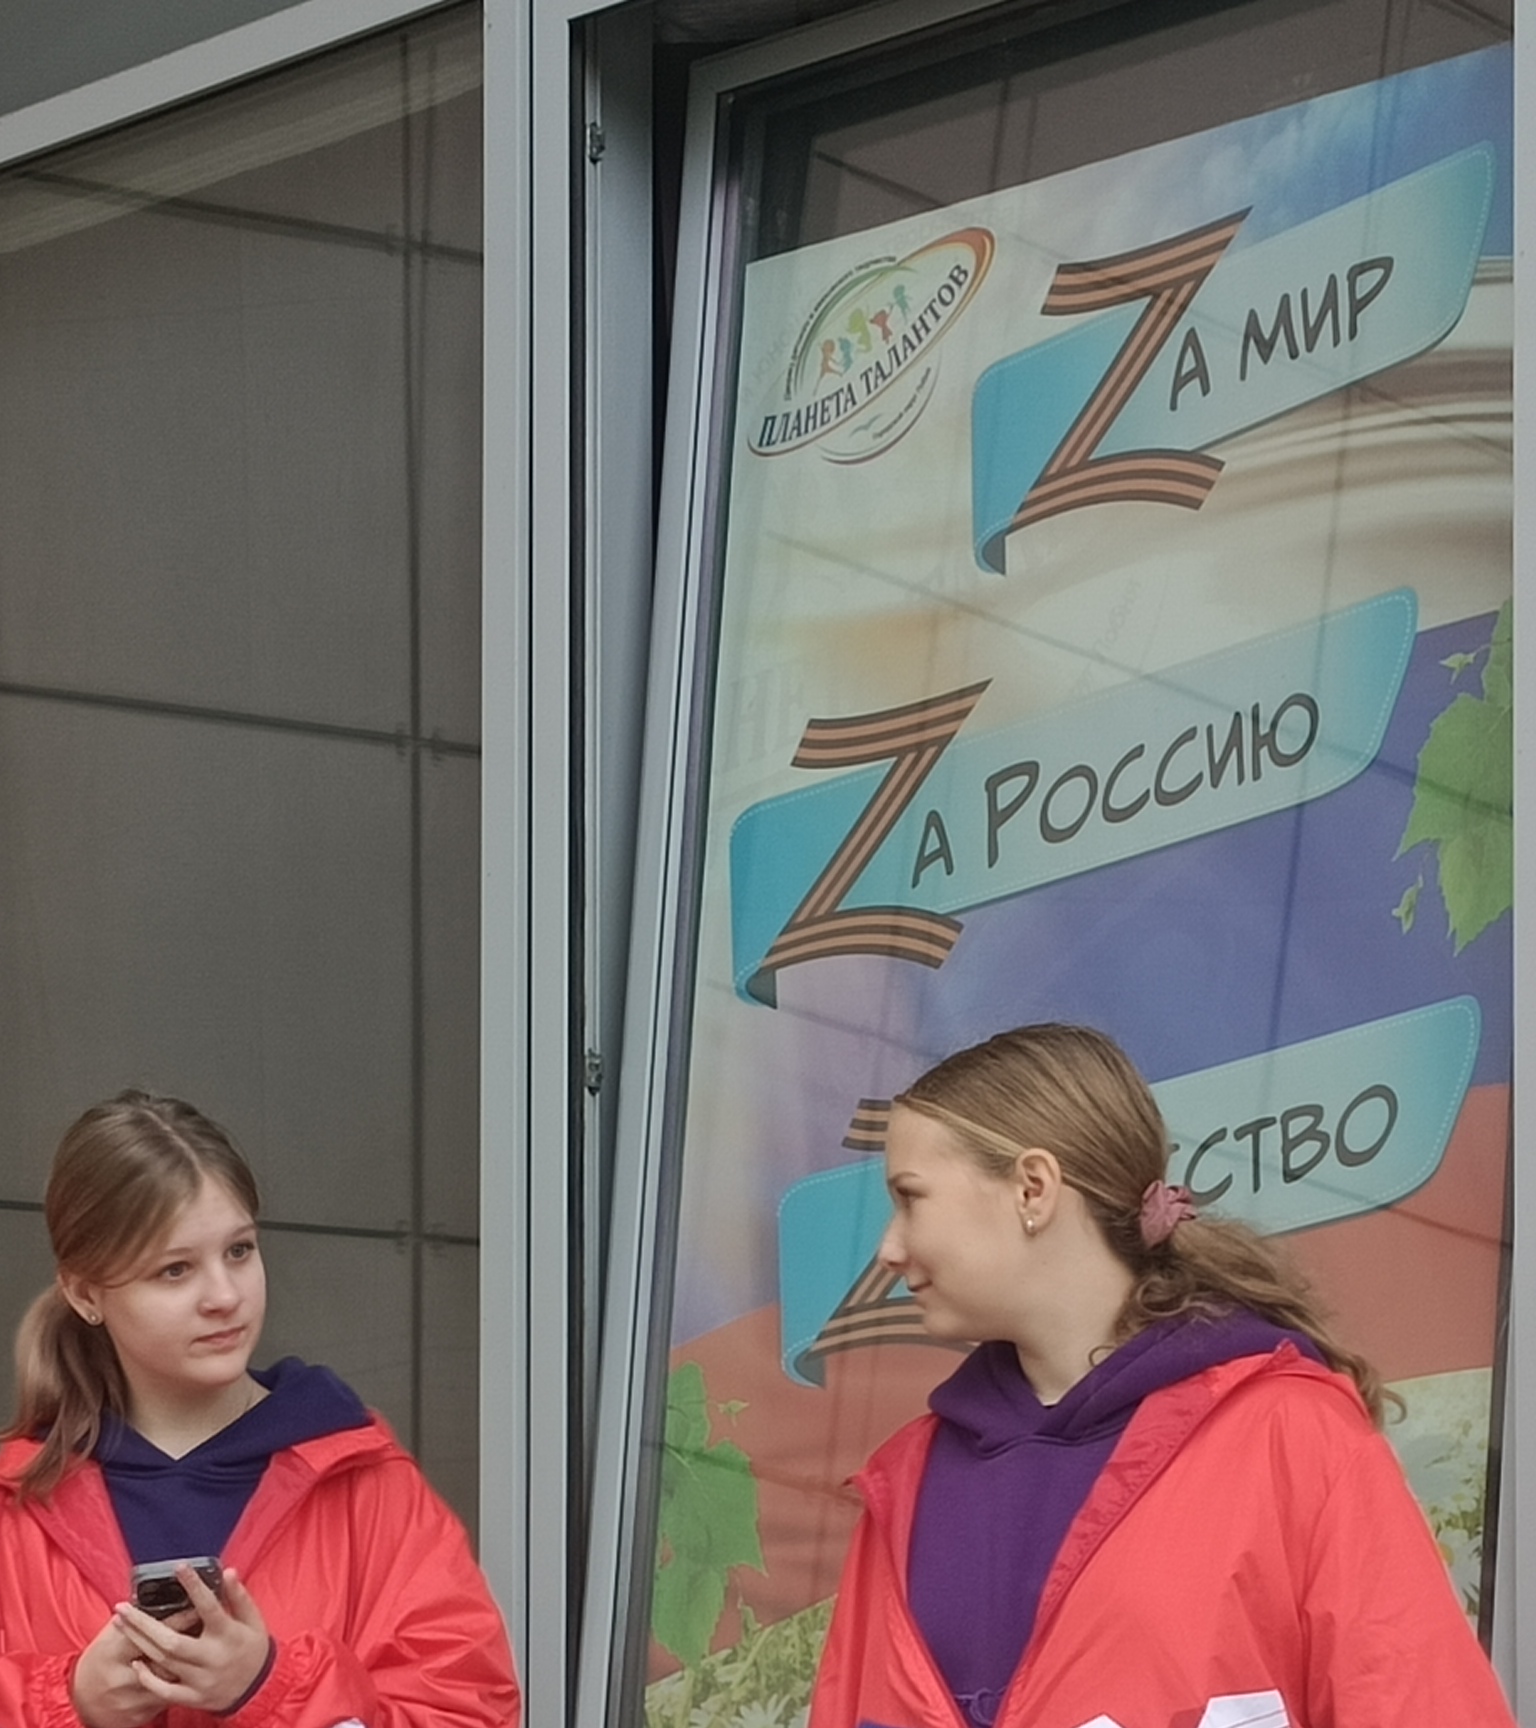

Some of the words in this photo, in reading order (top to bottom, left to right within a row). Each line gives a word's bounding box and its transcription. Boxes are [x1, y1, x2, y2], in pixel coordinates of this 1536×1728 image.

[757, 382, 858, 449] ПЛАНЕТА
[860, 264, 970, 397] ТАЛАНТОВ
[1240, 255, 1394, 381] МИР
[1167, 1083, 1399, 1202] СТВО
